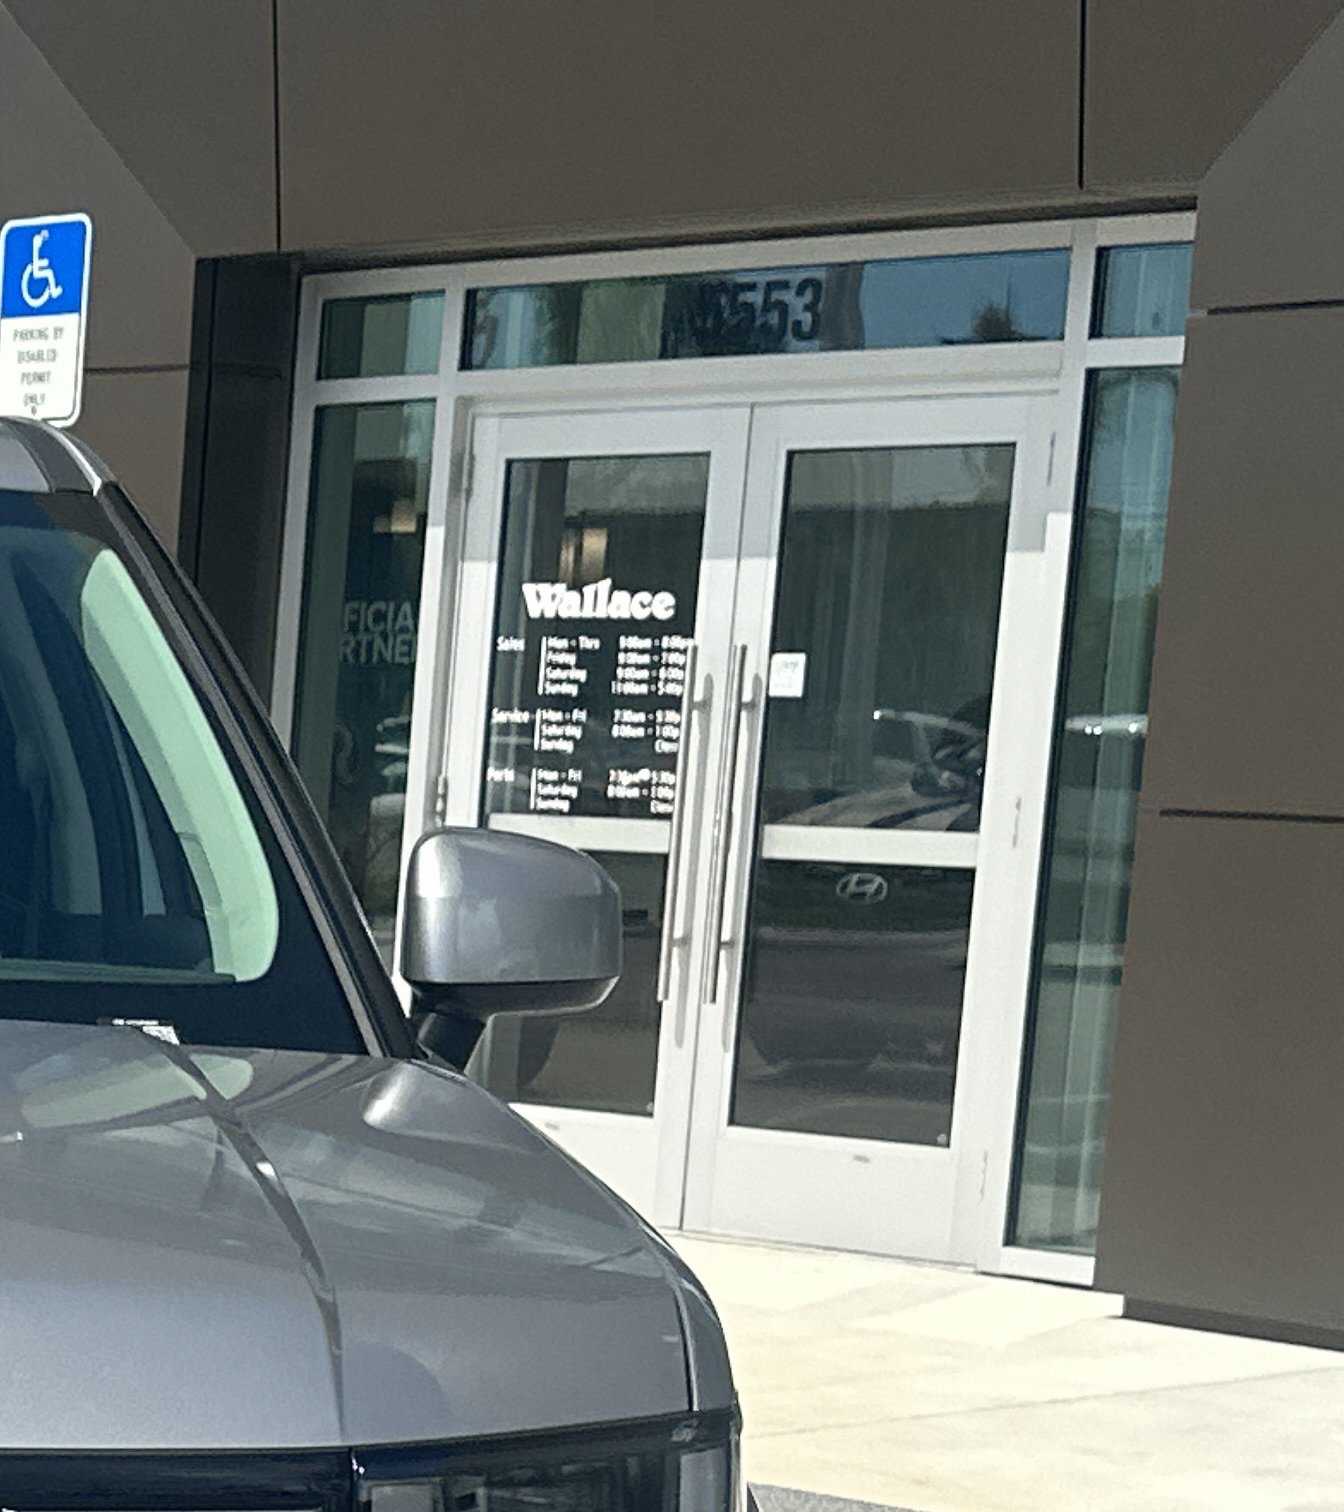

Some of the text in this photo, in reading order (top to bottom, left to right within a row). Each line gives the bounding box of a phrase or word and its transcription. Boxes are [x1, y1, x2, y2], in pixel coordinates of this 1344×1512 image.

[521, 577, 677, 621] Wallace
[497, 635, 525, 651] Sales
[546, 666, 587, 683] Saturday
[544, 680, 578, 697] Sunday
[492, 707, 529, 723] Service
